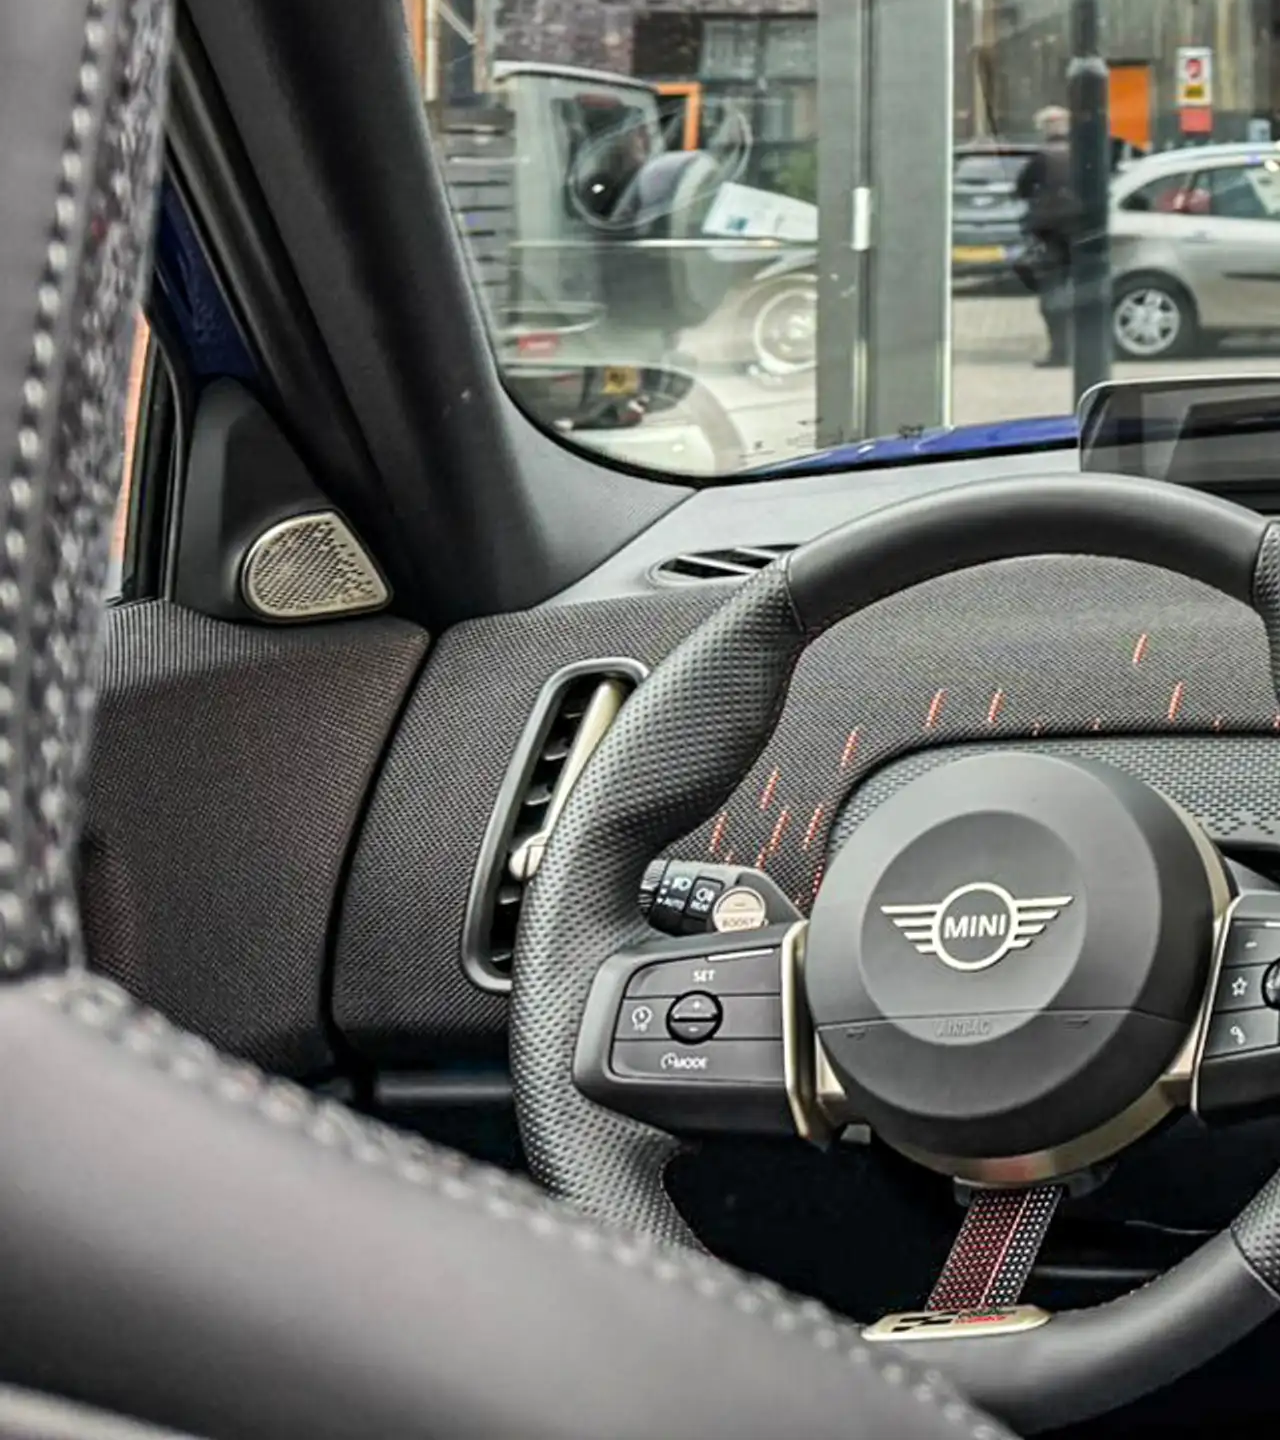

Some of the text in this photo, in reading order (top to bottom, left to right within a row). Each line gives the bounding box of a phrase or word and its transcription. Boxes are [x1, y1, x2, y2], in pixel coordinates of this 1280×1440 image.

[722, 917, 756, 928] BOOST
[943, 914, 1007, 940] MINI
[692, 969, 716, 983] SET
[676, 1056, 709, 1069] MODE
